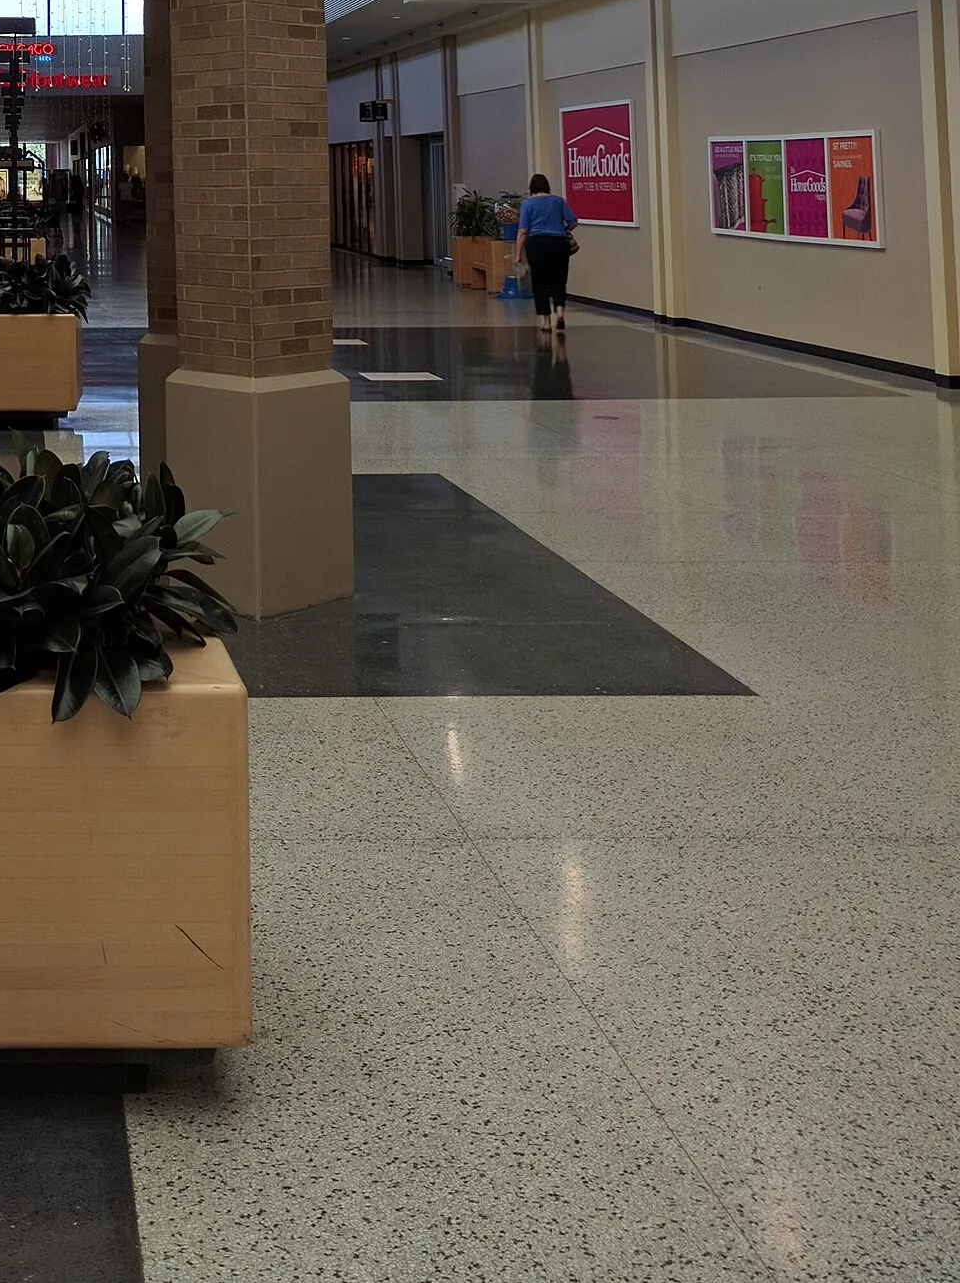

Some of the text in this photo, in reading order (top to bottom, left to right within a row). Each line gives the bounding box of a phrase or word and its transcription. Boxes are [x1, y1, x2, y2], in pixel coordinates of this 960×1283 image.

[29, 72, 110, 88] footwear
[567, 141, 630, 178] HomeGoods
[790, 177, 826, 193] HomeGoods
